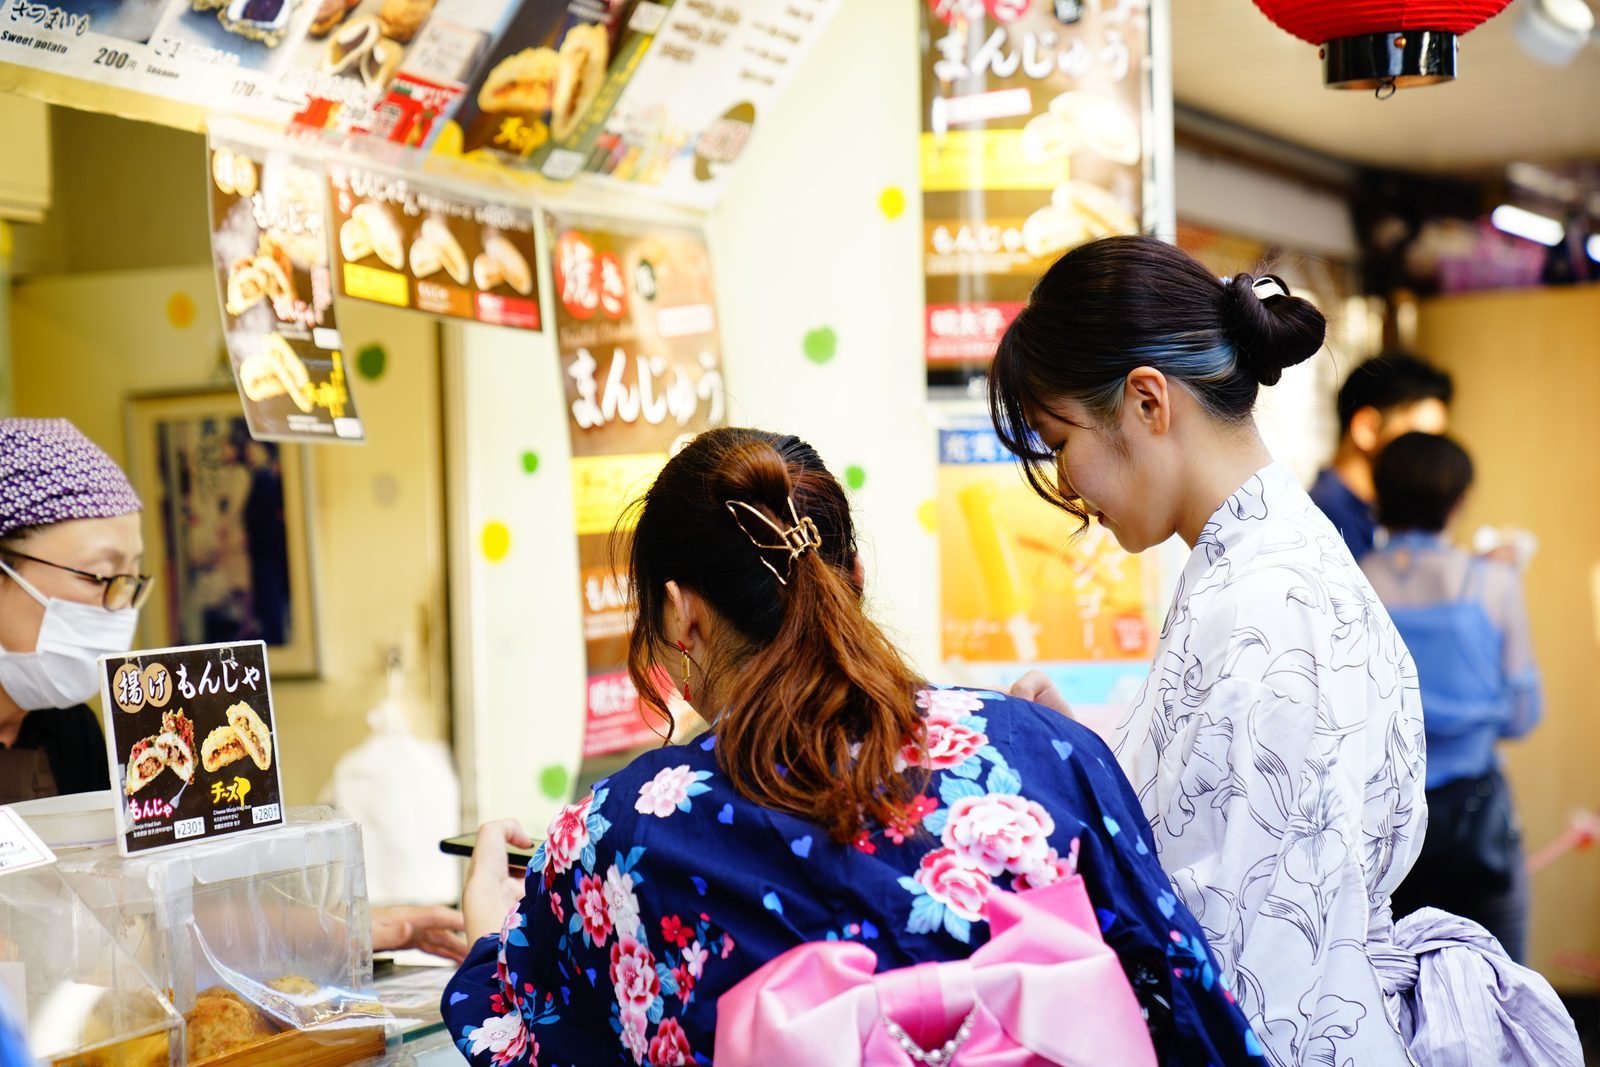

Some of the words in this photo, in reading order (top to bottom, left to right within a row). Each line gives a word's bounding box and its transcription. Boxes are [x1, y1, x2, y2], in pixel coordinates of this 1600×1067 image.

[10, 1, 88, 37] さつまいも
[1, 30, 34, 46] Sweet
[34, 39, 68, 54] potato
[932, 26, 1131, 80] まんじゅう
[567, 346, 725, 430] まんじゅう
[118, 660, 261, 706] 揚げもんじゃ
[128, 797, 173, 821] もんじゃ
[255, 807, 273, 822] ¥280
[176, 820, 198, 837] ¥230
